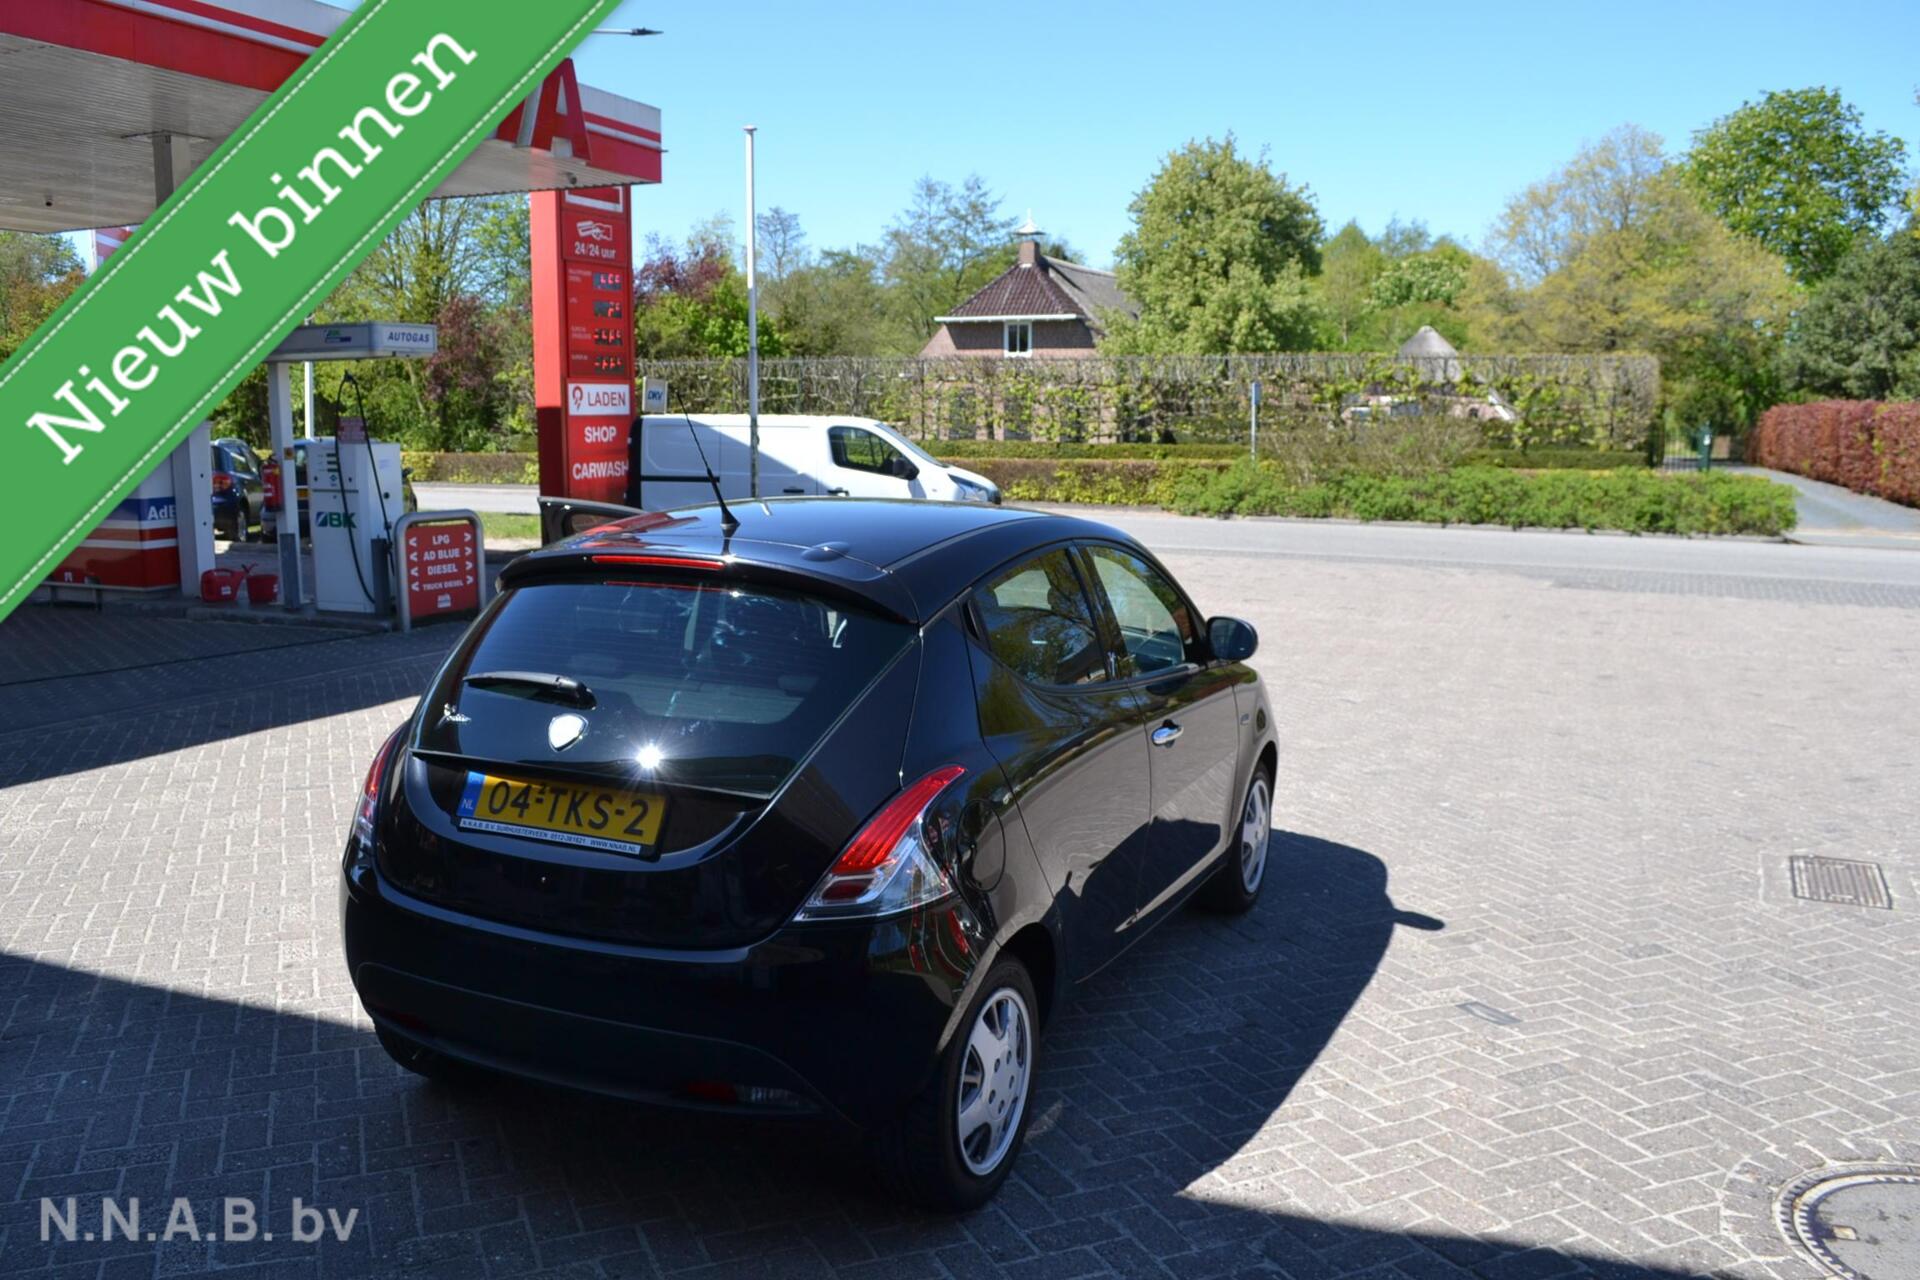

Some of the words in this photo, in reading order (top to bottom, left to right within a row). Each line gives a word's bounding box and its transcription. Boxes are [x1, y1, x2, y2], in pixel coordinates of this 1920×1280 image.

[574, 241, 600, 256] 24/24
[600, 247, 616, 258] uur
[387, 331, 430, 343] AUTOGAS
[587, 391, 626, 406] LADEN
[647, 390, 663, 401] DKV
[584, 426, 617, 443] SHOP
[572, 461, 629, 480] CARWASH
[432, 534, 450, 545] LPG
[423, 551, 436, 561] AD
[437, 548, 460, 560] BLUE
[427, 563, 458, 576] DIESEL
[422, 583, 443, 591] TRUCK
[444, 580, 464, 589] DIESEL
[461, 798, 474, 810] NL
[488, 780, 650, 837] 04-TKS-2
